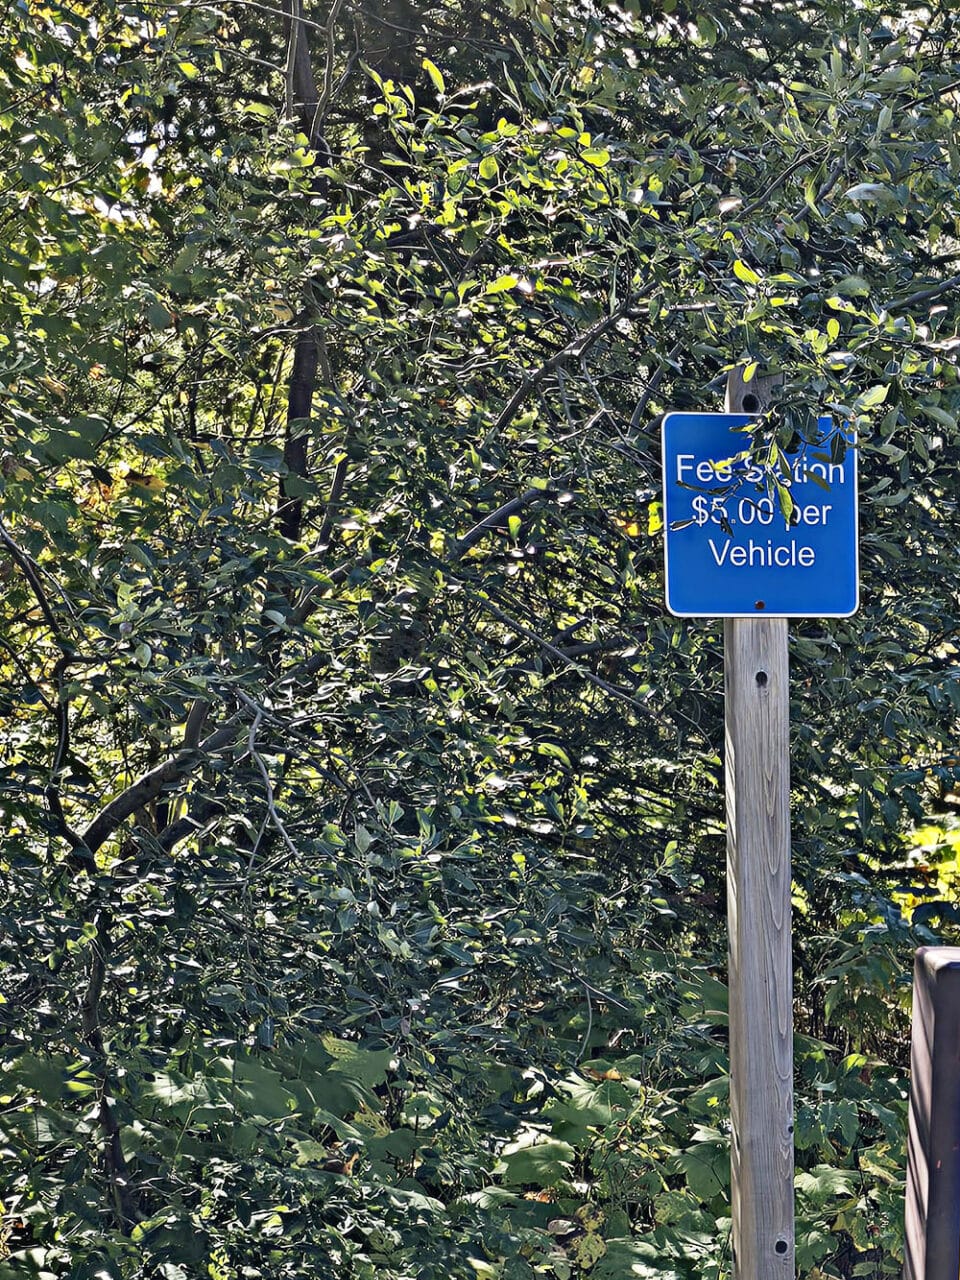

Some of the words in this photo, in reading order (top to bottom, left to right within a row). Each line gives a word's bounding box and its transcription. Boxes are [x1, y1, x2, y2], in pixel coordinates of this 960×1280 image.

[676, 454, 733, 483] Fee
[691, 494, 774, 527] $5.00
[708, 538, 815, 567] Vehicle
